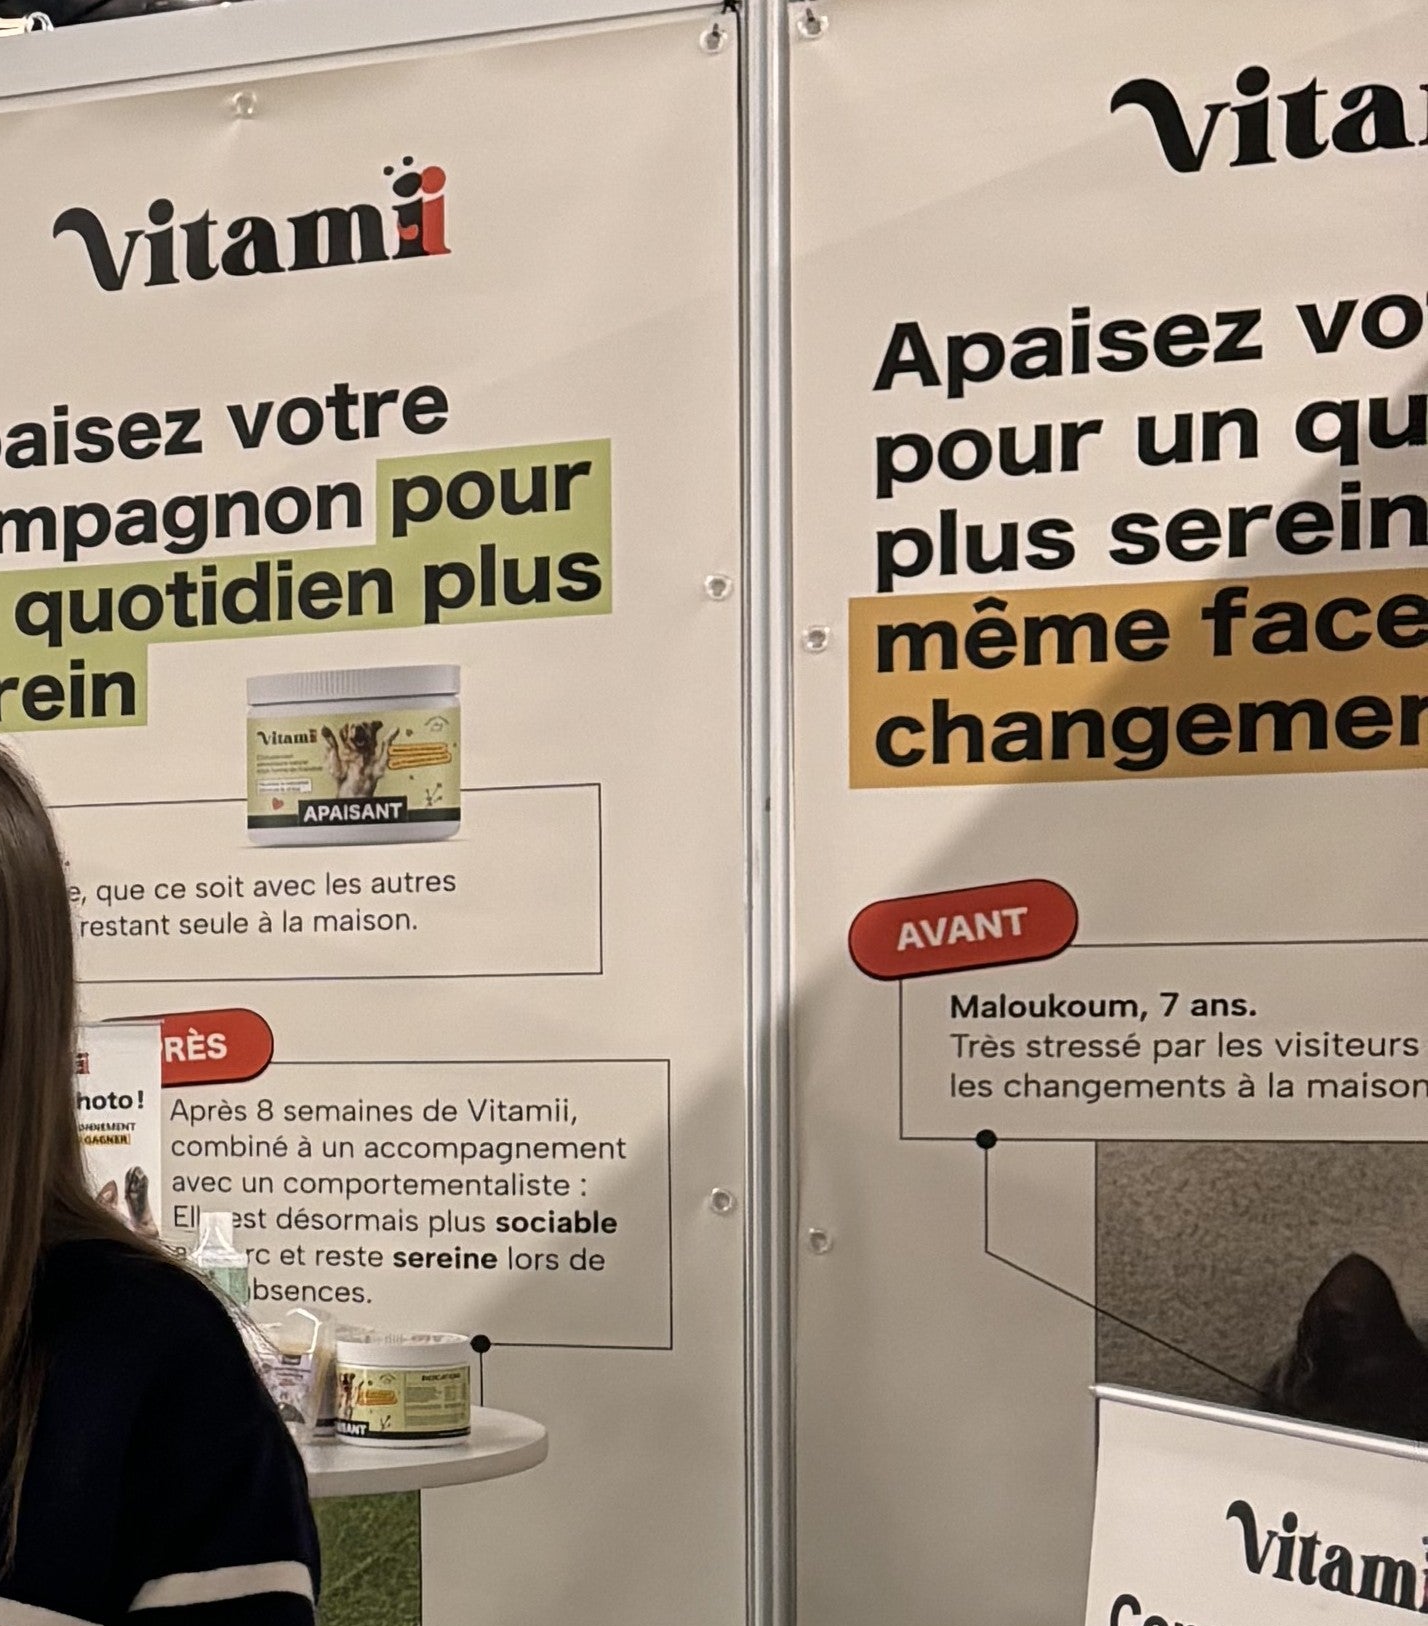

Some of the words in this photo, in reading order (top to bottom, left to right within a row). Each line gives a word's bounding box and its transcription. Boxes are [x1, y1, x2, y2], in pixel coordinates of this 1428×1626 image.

[872, 305, 1263, 400] Apaisez
[226, 382, 449, 450] votre
[875, 418, 1104, 500] pour
[1137, 407, 1259, 467] un
[392, 460, 593, 539] pour
[876, 508, 1076, 594] plus
[1108, 480, 1428, 566] serein
[14, 558, 394, 648] quotidien
[423, 542, 602, 625] plus
[877, 595, 1171, 674] même
[1201, 585, 1428, 657] face
[303, 801, 403, 823] APAISANT
[80, 914, 171, 938] restant
[179, 911, 249, 935] seule
[258, 910, 273, 934] à
[282, 909, 303, 934] la
[313, 907, 418, 933] maison.
[897, 906, 1028, 951] AVANT
[950, 992, 1148, 1023] Maloukoum,
[1159, 991, 1180, 1018] 7
[1190, 998, 1257, 1017] ans.
[949, 1033, 1016, 1059] Très
[1026, 1032, 1141, 1059] stressé
[1153, 1038, 1207, 1065] par
[1218, 1031, 1263, 1058] les
[1274, 1031, 1420, 1058] visiteurs
[169, 1098, 248, 1127] Après
[256, 1098, 274, 1122] 8
[283, 1098, 413, 1123] semaines
[422, 1098, 458, 1123] de
[467, 1097, 577, 1126] Vitamii,
[171, 1133, 289, 1158] combiné
[297, 1135, 312, 1158] à
[322, 1140, 355, 1159] un
[364, 1137, 627, 1166] accompagnement
[172, 1175, 232, 1194] avec
[242, 1176, 274, 1194] un
[283, 1171, 571, 1201] comportementaliste
